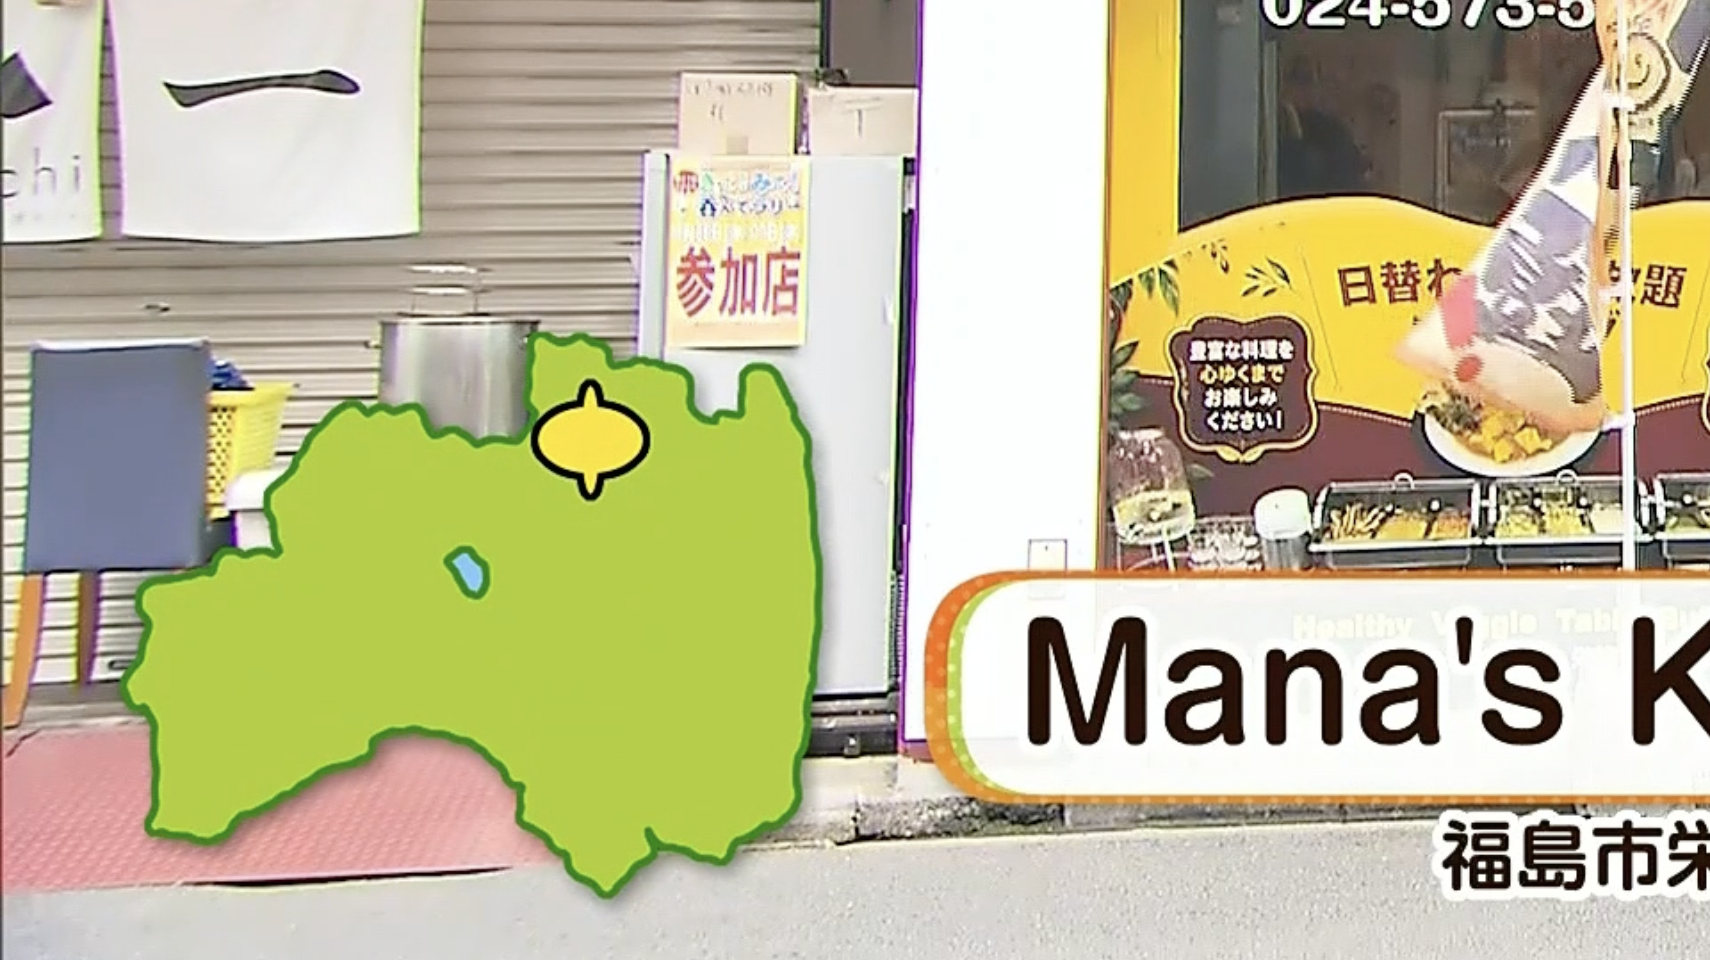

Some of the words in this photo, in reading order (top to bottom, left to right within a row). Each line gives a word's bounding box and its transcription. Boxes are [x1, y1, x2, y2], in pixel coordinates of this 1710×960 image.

[676, 245, 801, 318] 参加店
[1189, 338, 1295, 362] 豊富な料理を
[1200, 363, 1285, 385] 心ゆくまで
[1204, 386, 1278, 409] お楽しみ
[1206, 409, 1283, 432] ください!
